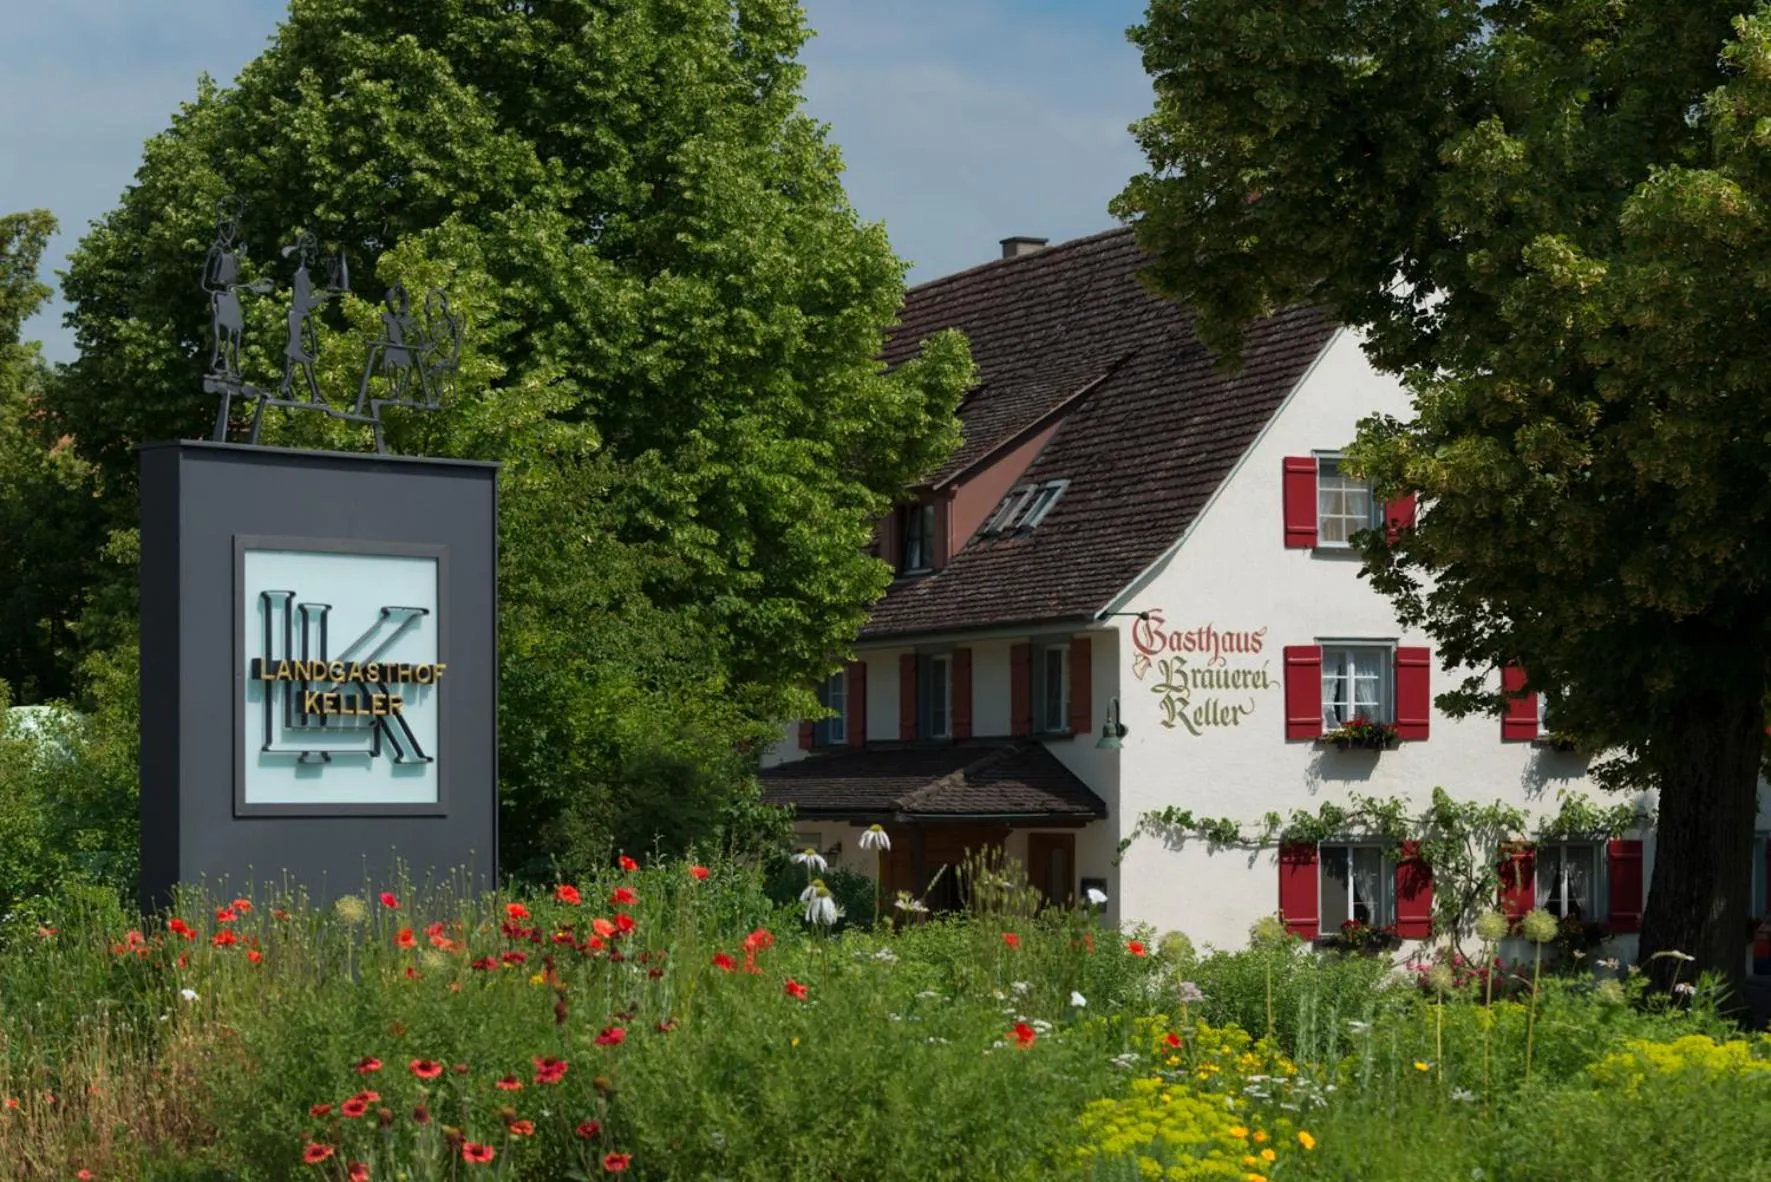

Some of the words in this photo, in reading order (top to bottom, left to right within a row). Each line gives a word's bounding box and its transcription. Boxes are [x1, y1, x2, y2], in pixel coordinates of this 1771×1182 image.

[1132, 608, 1267, 668] Gasthaus
[259, 658, 447, 684] LANDGASTHOF
[1151, 655, 1280, 698] Brauerei
[304, 690, 405, 716] KELLER
[1160, 694, 1255, 737] Keller
